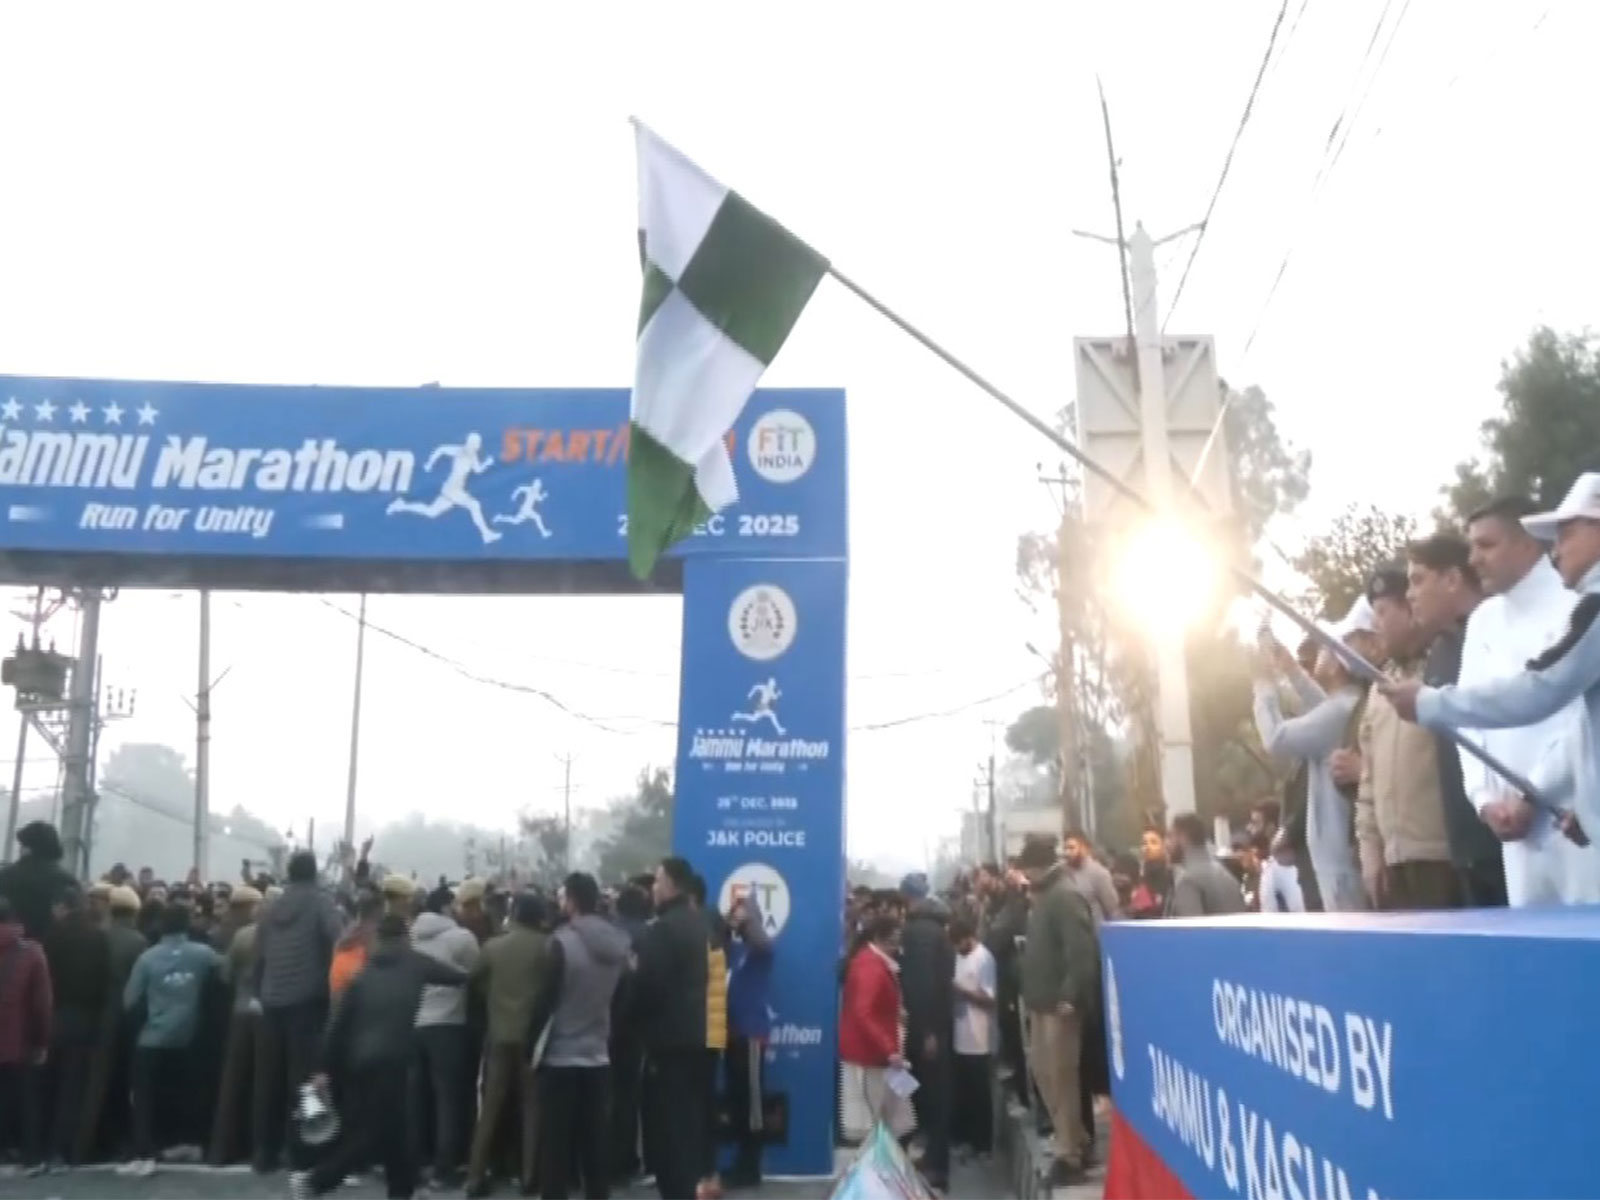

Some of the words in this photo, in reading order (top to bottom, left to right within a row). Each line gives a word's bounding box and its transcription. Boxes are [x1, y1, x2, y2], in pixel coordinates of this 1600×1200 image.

[152, 435, 415, 492] Marathon
[757, 454, 804, 469] INDIA
[80, 502, 136, 530] Run
[142, 503, 191, 532] for
[194, 505, 276, 539] Unity
[738, 514, 800, 536] 2025
[745, 737, 830, 759] Marathon
[706, 830, 740, 847] J&K
[744, 830, 806, 847] POLICE
[1211, 977, 1341, 1094] ORGANISED
[1344, 1010, 1394, 1121] BY
[1147, 1042, 1215, 1171] JAMMU
[1216, 1086, 1240, 1194] &
